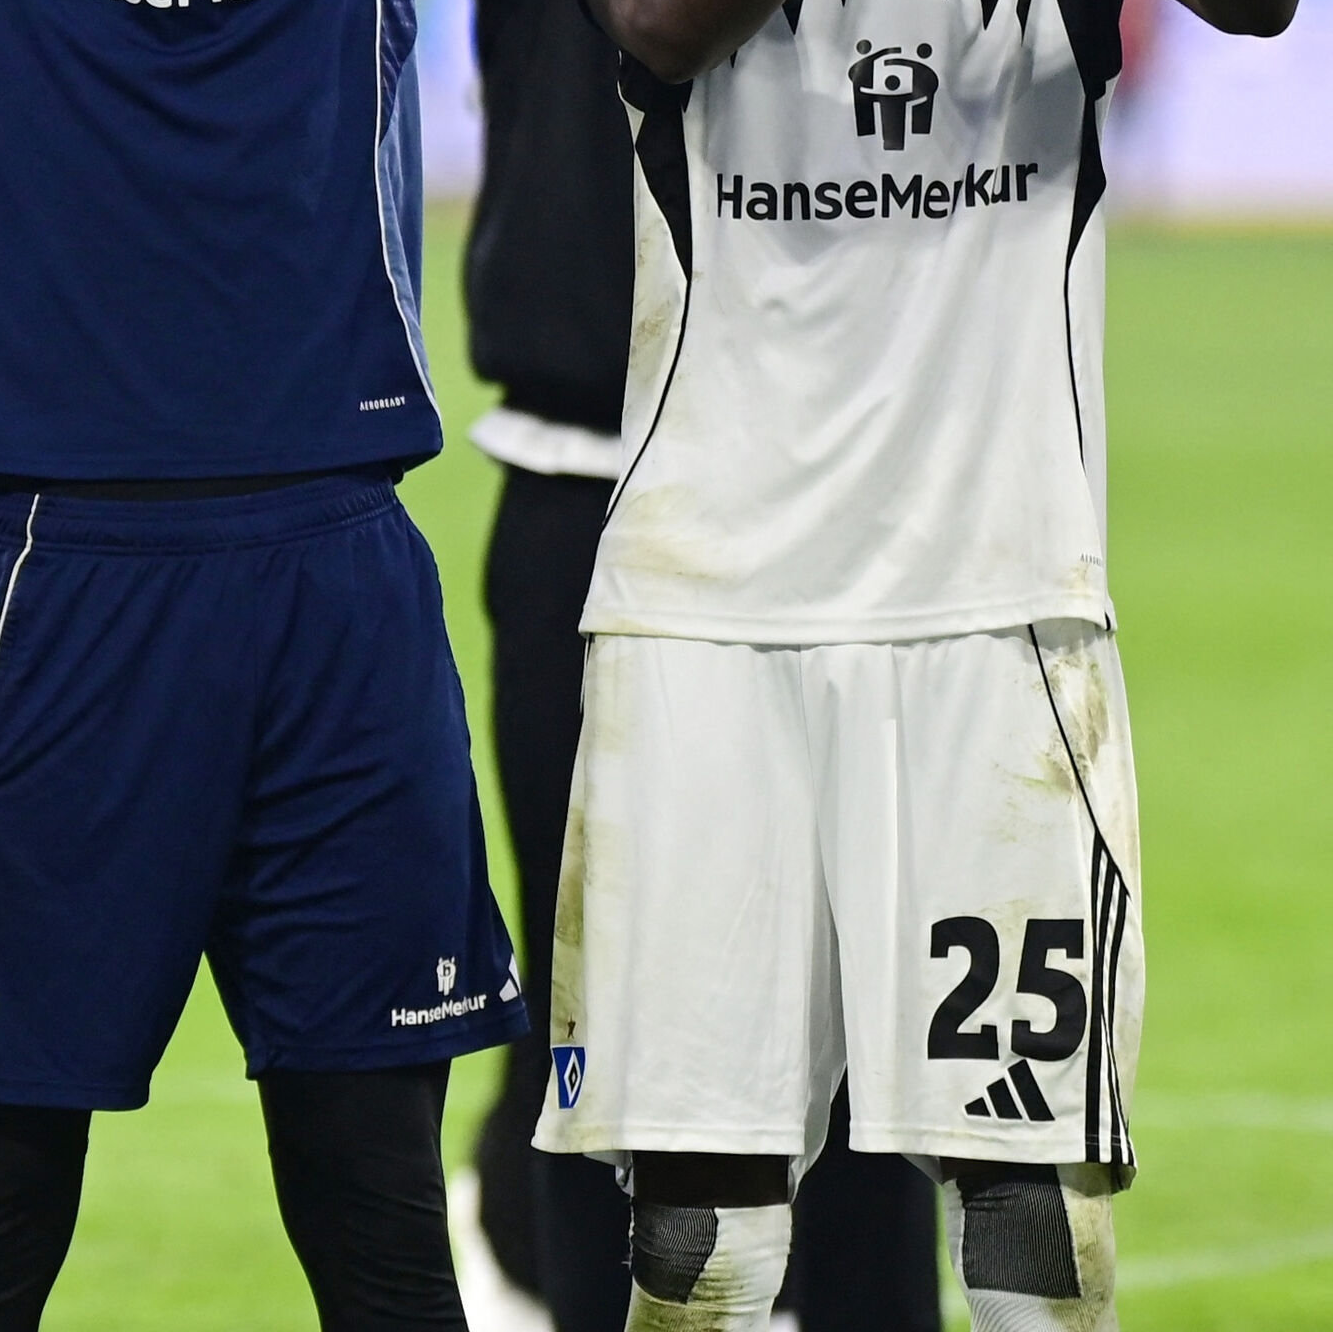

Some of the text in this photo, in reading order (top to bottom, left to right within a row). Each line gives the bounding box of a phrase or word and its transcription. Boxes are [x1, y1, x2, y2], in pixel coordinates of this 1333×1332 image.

[716, 162, 1039, 221] HanseMerkur
[359, 395, 406, 412] AEROREADY
[927, 915, 1088, 1062] 25
